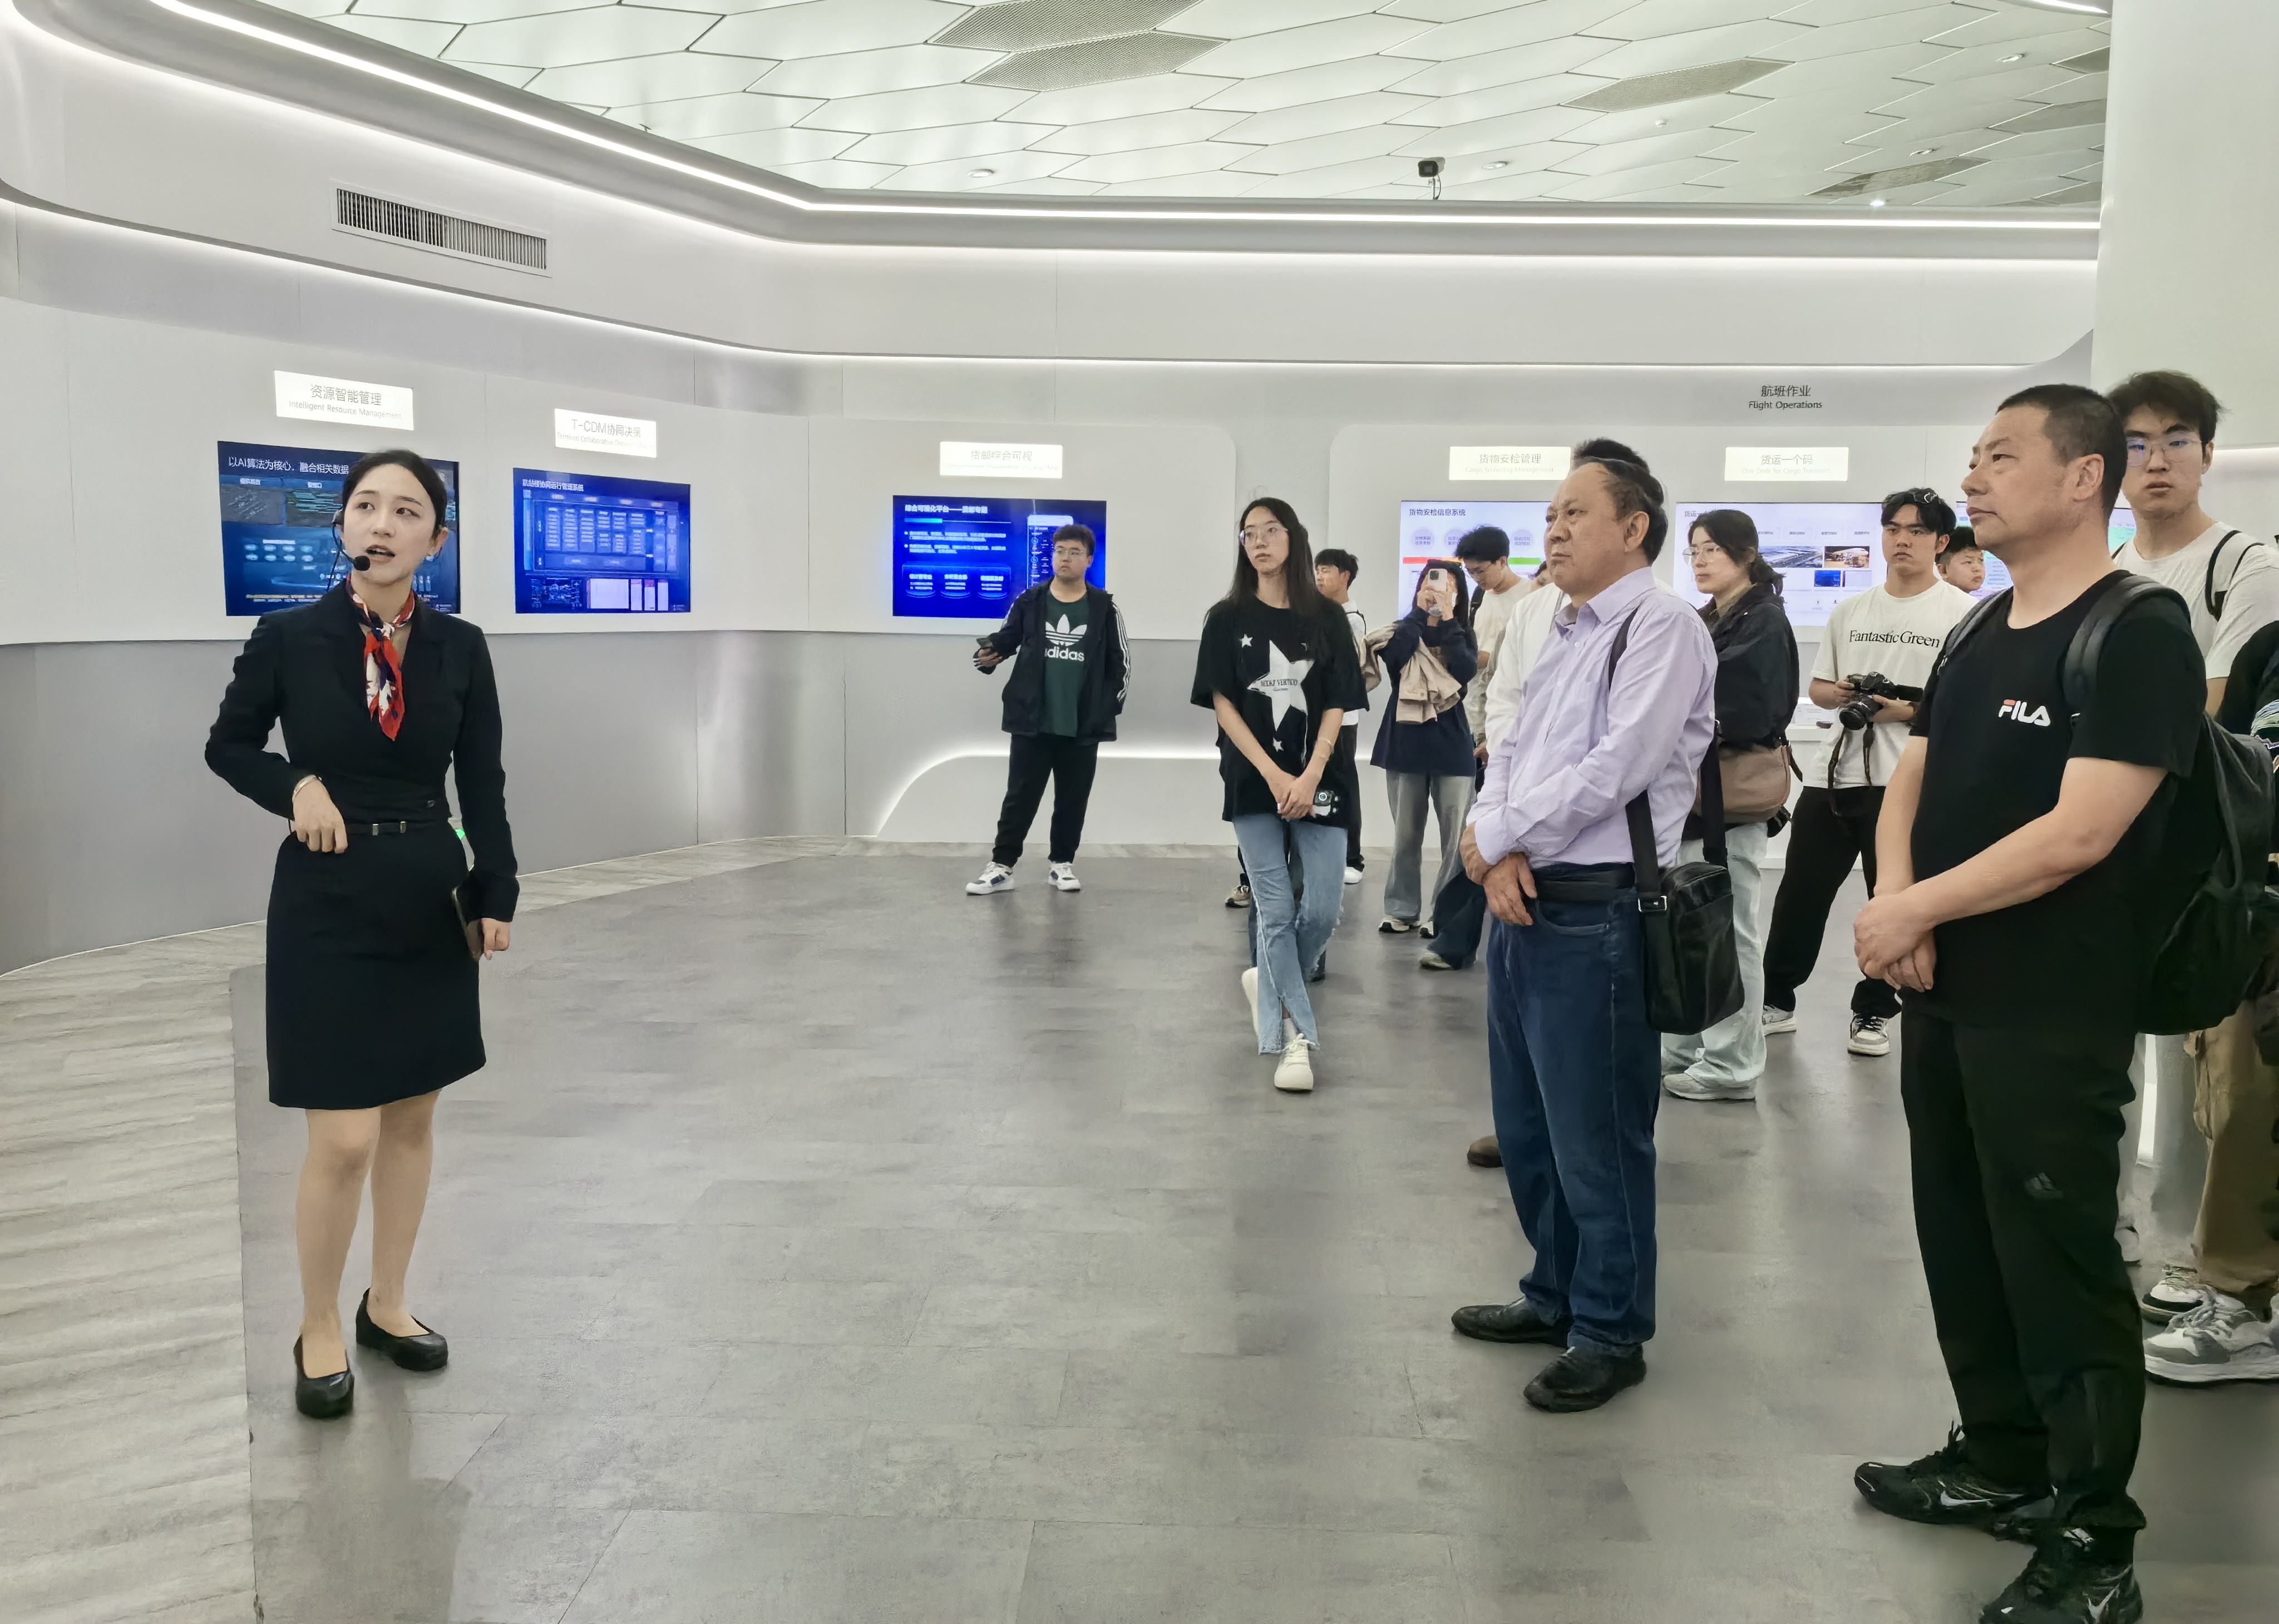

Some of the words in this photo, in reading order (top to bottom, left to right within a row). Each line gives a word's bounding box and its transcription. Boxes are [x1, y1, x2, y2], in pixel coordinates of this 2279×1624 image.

[310, 383, 382, 407] 资源智能管理
[1761, 385, 1811, 397] 航班作业
[289, 400, 325, 411] Intelligent
[327, 404, 357, 415] Resource
[359, 408, 402, 419] Management
[1749, 401, 1773, 411] Flight
[1775, 401, 1822, 410] Operations
[571, 419, 641, 438] T-CDM协同决策
[557, 432, 579, 441] Terminal
[580, 436, 614, 446] Collaborative
[971, 450, 1033, 461] 货邮综合可视
[1479, 453, 1541, 464] 货物安检管理
[1761, 454, 1813, 465] 货运一个码
[1849, 630, 1900, 643] Fantastic
[1900, 631, 1940, 648] Green
[1998, 699, 2051, 727] FILA
